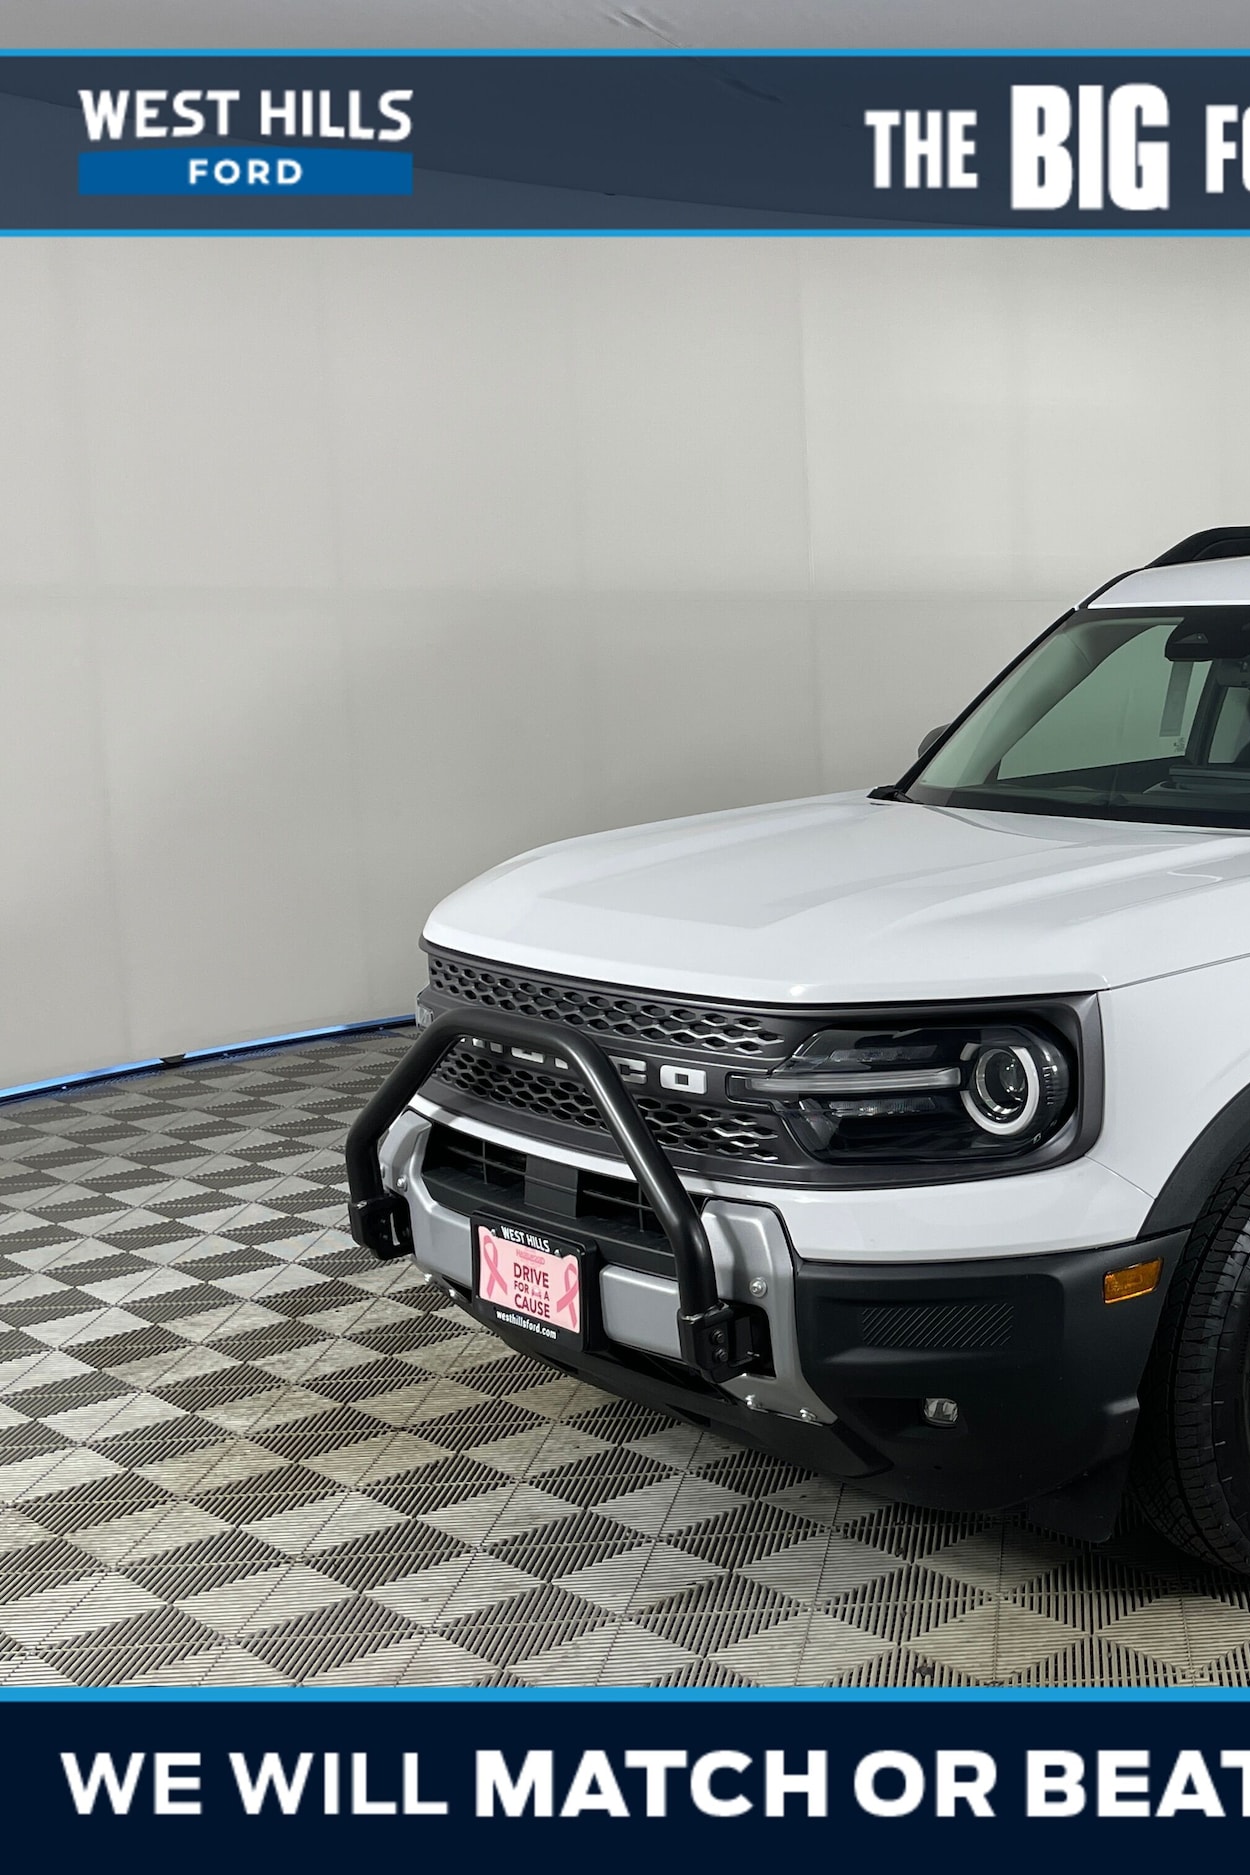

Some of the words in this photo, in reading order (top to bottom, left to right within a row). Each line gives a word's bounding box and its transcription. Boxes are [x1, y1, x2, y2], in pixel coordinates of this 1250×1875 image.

[501, 1225, 525, 1244] WEST
[527, 1233, 550, 1253] HILLS
[513, 1262, 549, 1288] DRIVE
[514, 1280, 530, 1294] FOR
[543, 1291, 550, 1301] A
[514, 1294, 551, 1318] CAUSE
[496, 1311, 557, 1340] westhillsford.com
